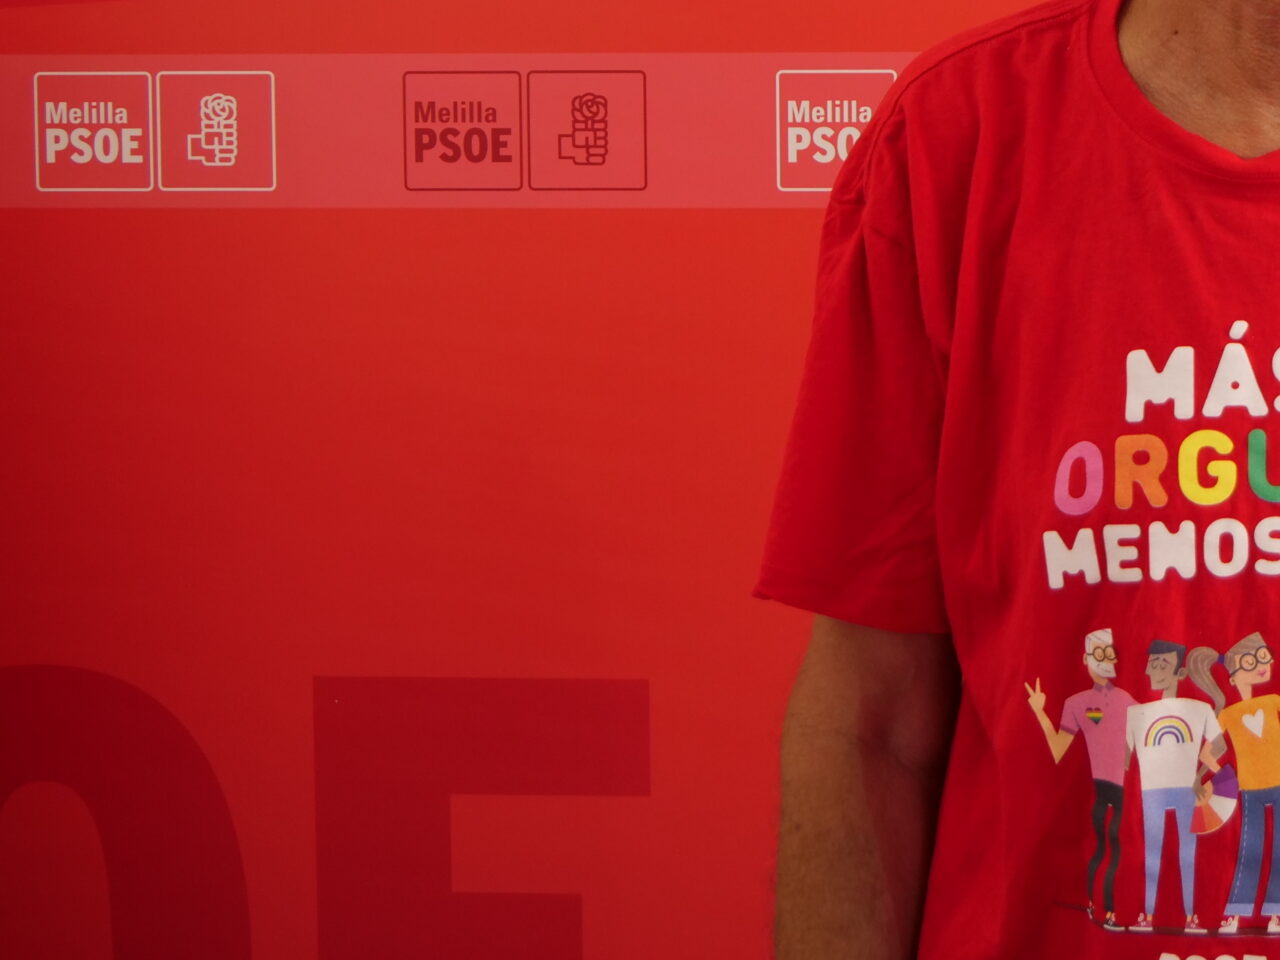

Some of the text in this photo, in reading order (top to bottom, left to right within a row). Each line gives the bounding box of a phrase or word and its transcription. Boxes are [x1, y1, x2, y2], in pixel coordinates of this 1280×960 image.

[44, 101, 128, 125] Melilla
[414, 100, 497, 124] Melilla
[787, 99, 872, 124] Melilla
[45, 127, 144, 164] PSOE
[414, 127, 513, 164] PSOE
[787, 126, 861, 164] PSO
